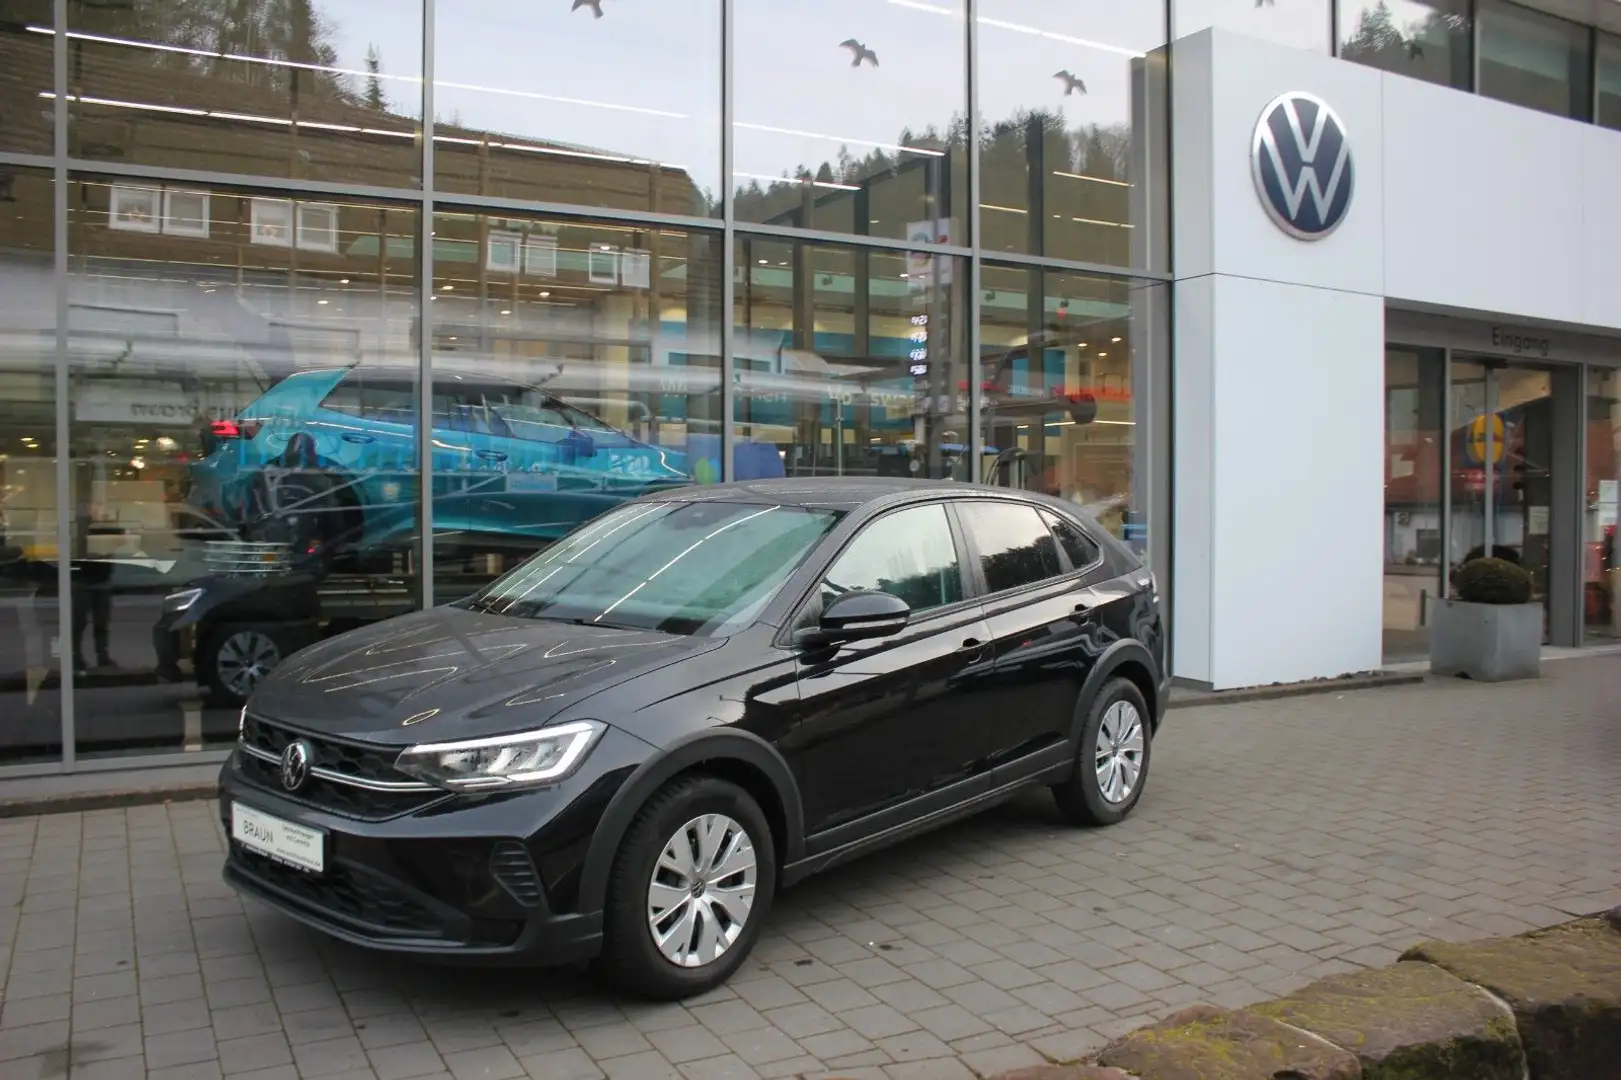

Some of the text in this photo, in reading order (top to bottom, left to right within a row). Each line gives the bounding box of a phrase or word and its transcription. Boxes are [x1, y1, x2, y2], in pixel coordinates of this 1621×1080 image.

[1256, 94, 1351, 228] VW
[1492, 326, 1548, 357] Eingang
[243, 819, 274, 845] BRAUN
